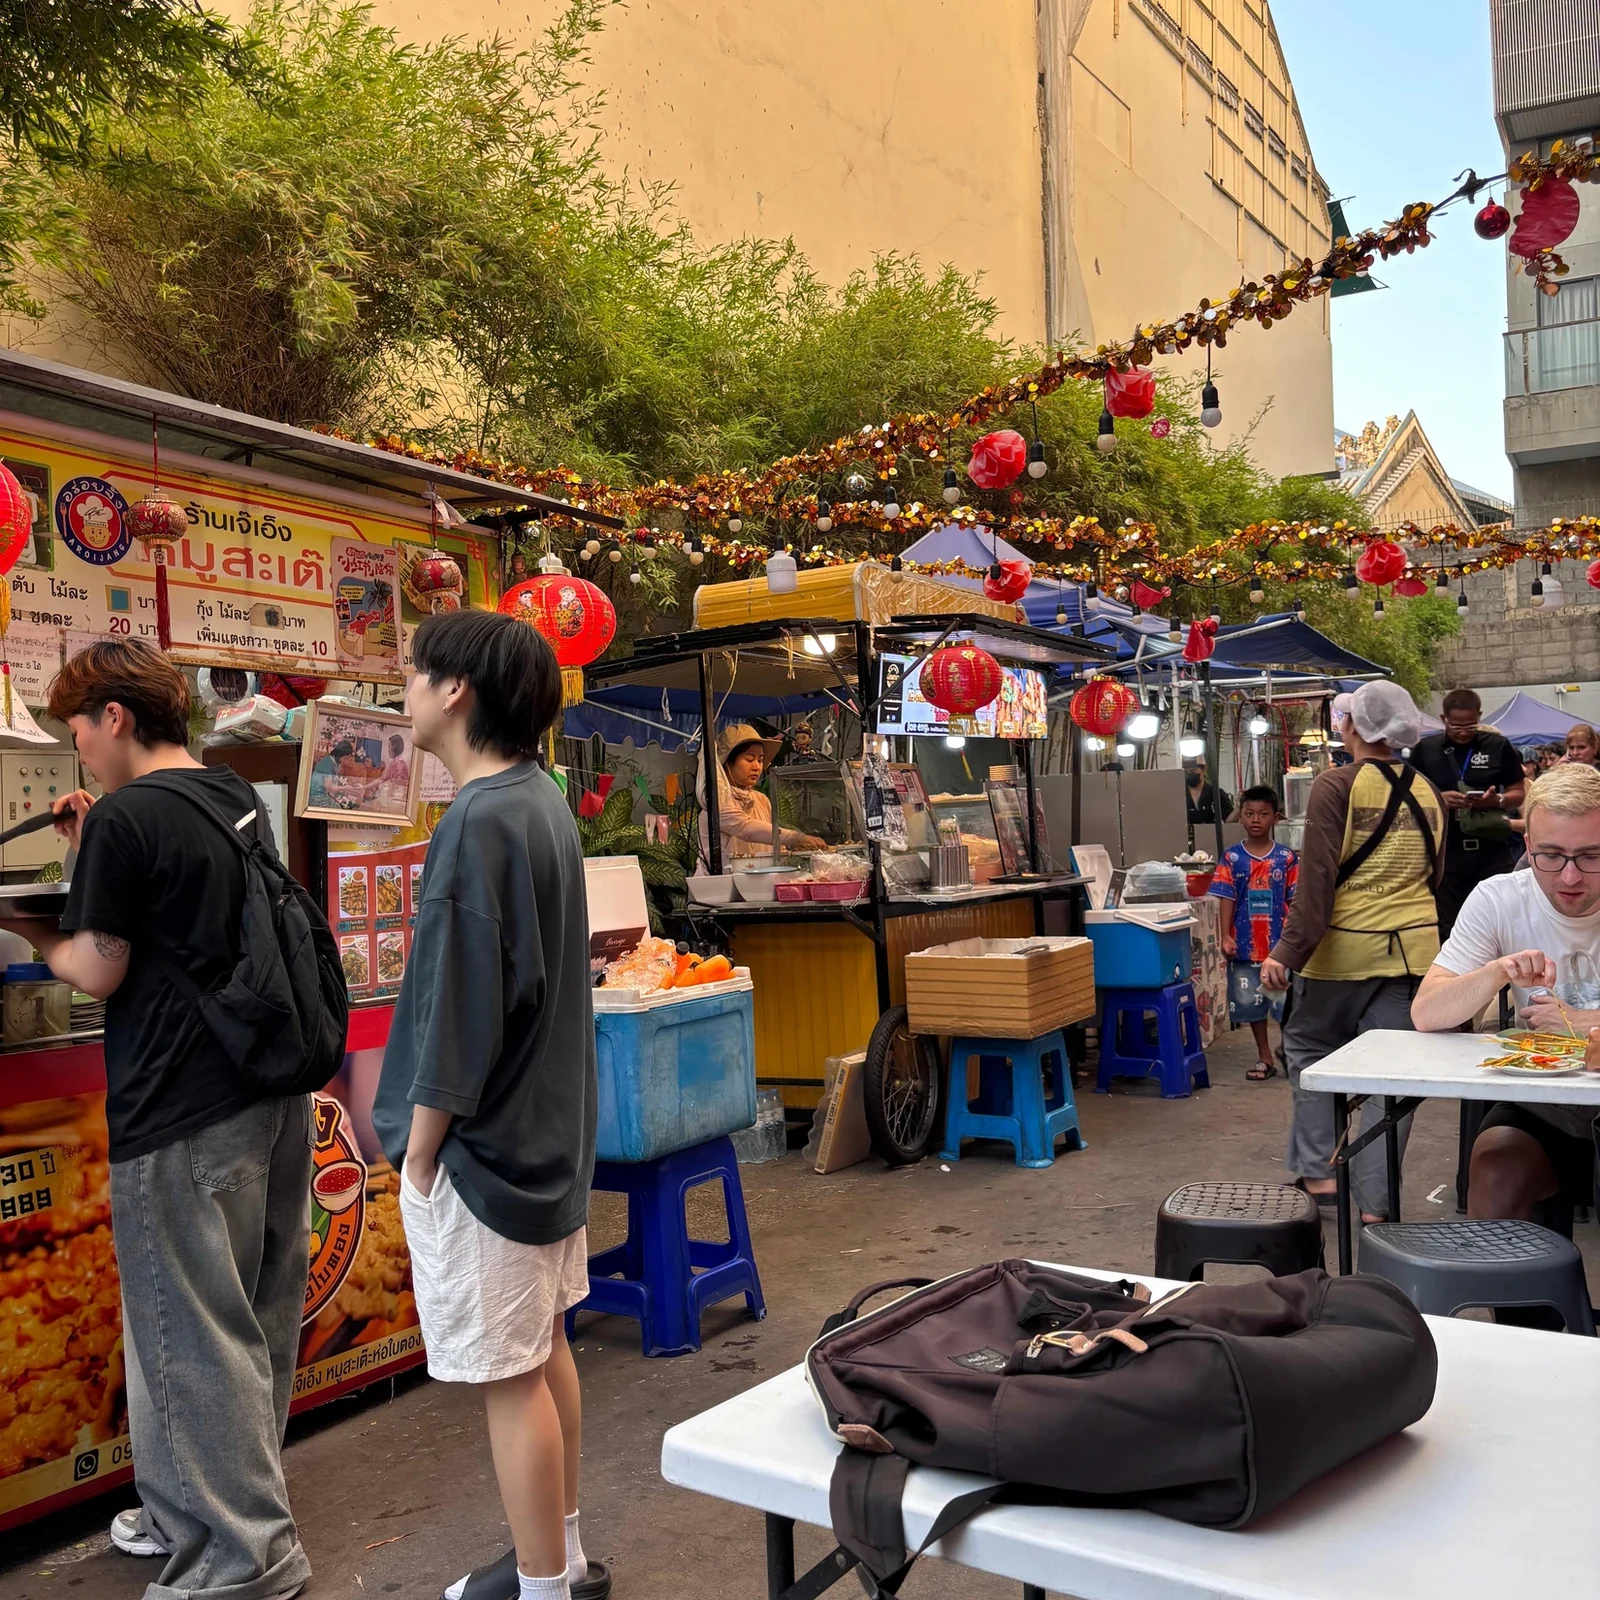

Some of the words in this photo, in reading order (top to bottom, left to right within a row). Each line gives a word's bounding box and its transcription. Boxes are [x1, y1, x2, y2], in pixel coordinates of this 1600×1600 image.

[68, 538, 125, 562] AROIJANG
[12, 574, 35, 594] ตับ
[47, 577, 88, 601] ไม้ละ
[137, 596, 158, 609] บา
[109, 616, 131, 635] 20
[138, 623, 159, 636] บา
[196, 599, 213, 621] กุ้ง
[217, 600, 250, 621] ไม้ละ
[282, 615, 306, 629] บาท
[197, 624, 268, 648] เพิ่มแตงกวา
[273, 639, 305, 655] ชุดละ
[311, 640, 328, 656] 10
[19, 676, 40, 684] order
[1343, 881, 1385, 894] WORLD
[0, 1159, 35, 1186] 30
[112, 1441, 132, 1464] 09
